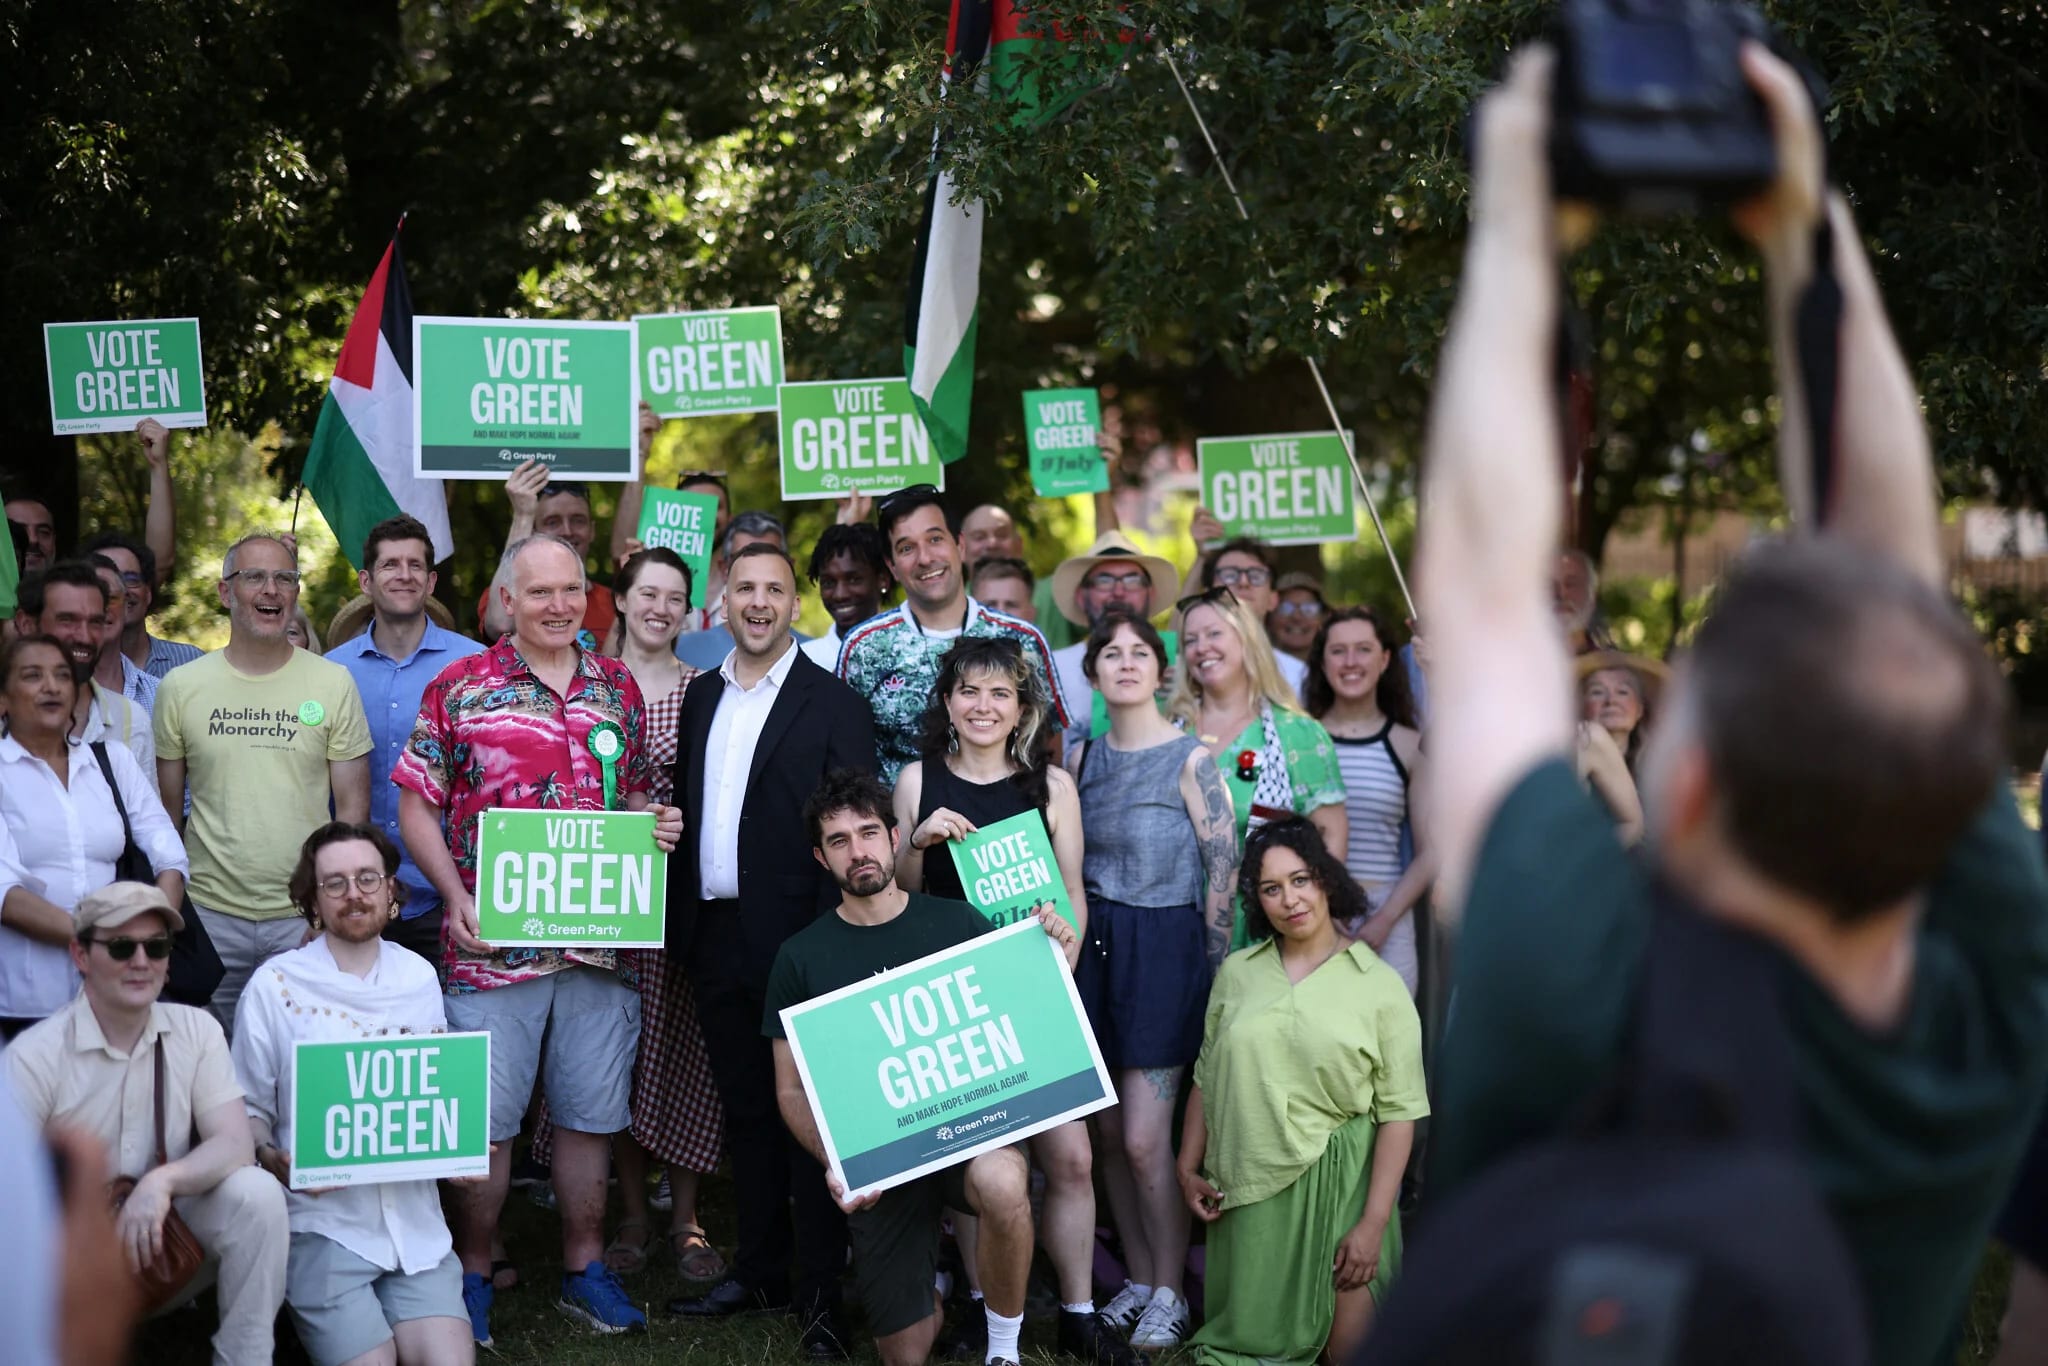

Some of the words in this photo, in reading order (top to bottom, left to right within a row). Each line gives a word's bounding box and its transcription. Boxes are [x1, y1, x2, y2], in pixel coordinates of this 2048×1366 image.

[682, 317, 731, 342] VOTE
[86, 329, 162, 368] VOTE
[483, 337, 570, 379] VOTE
[647, 340, 773, 394] GREEN
[75, 367, 181, 413] GREEN
[470, 382, 583, 425] GREEN
[833, 386, 886, 414] VOTE
[1038, 400, 1087, 426] VOTE
[792, 413, 930, 472] GREEN
[1034, 424, 1097, 450] GREEN
[1250, 440, 1301, 468] VOTE
[512, 451, 536, 460] Green
[536, 452, 557, 462] Party
[842, 476, 875, 488] Green
[876, 474, 906, 486] Party
[1212, 465, 1344, 522] GREEN
[656, 500, 703, 530] VOTE
[645, 525, 706, 557] GREEN
[208, 721, 297, 742] Monarchy
[209, 707, 271, 721] Abolish
[276, 708, 299, 723] the
[545, 818, 605, 849] VOTE
[970, 830, 1034, 874] VOTE
[493, 851, 653, 915] GREEN
[975, 856, 1053, 906] GREEN
[548, 923, 585, 936] Green
[588, 924, 622, 938] Party
[870, 964, 990, 1048] VOTE
[345, 1047, 440, 1099] VOTE
[877, 1013, 1025, 1109] GREEN
[896, 1114, 915, 1128] AND
[915, 1104, 940, 1121] MAKE
[940, 1096, 962, 1112] HOPE
[963, 1082, 1000, 1104] NORMAL
[1000, 1071, 1030, 1090] AGAIN!
[325, 1098, 459, 1159] GREEN
[954, 1119, 983, 1134] Green
[983, 1109, 1008, 1125] Party
[309, 1173, 331, 1182] Green
[332, 1171, 352, 1182] Party
